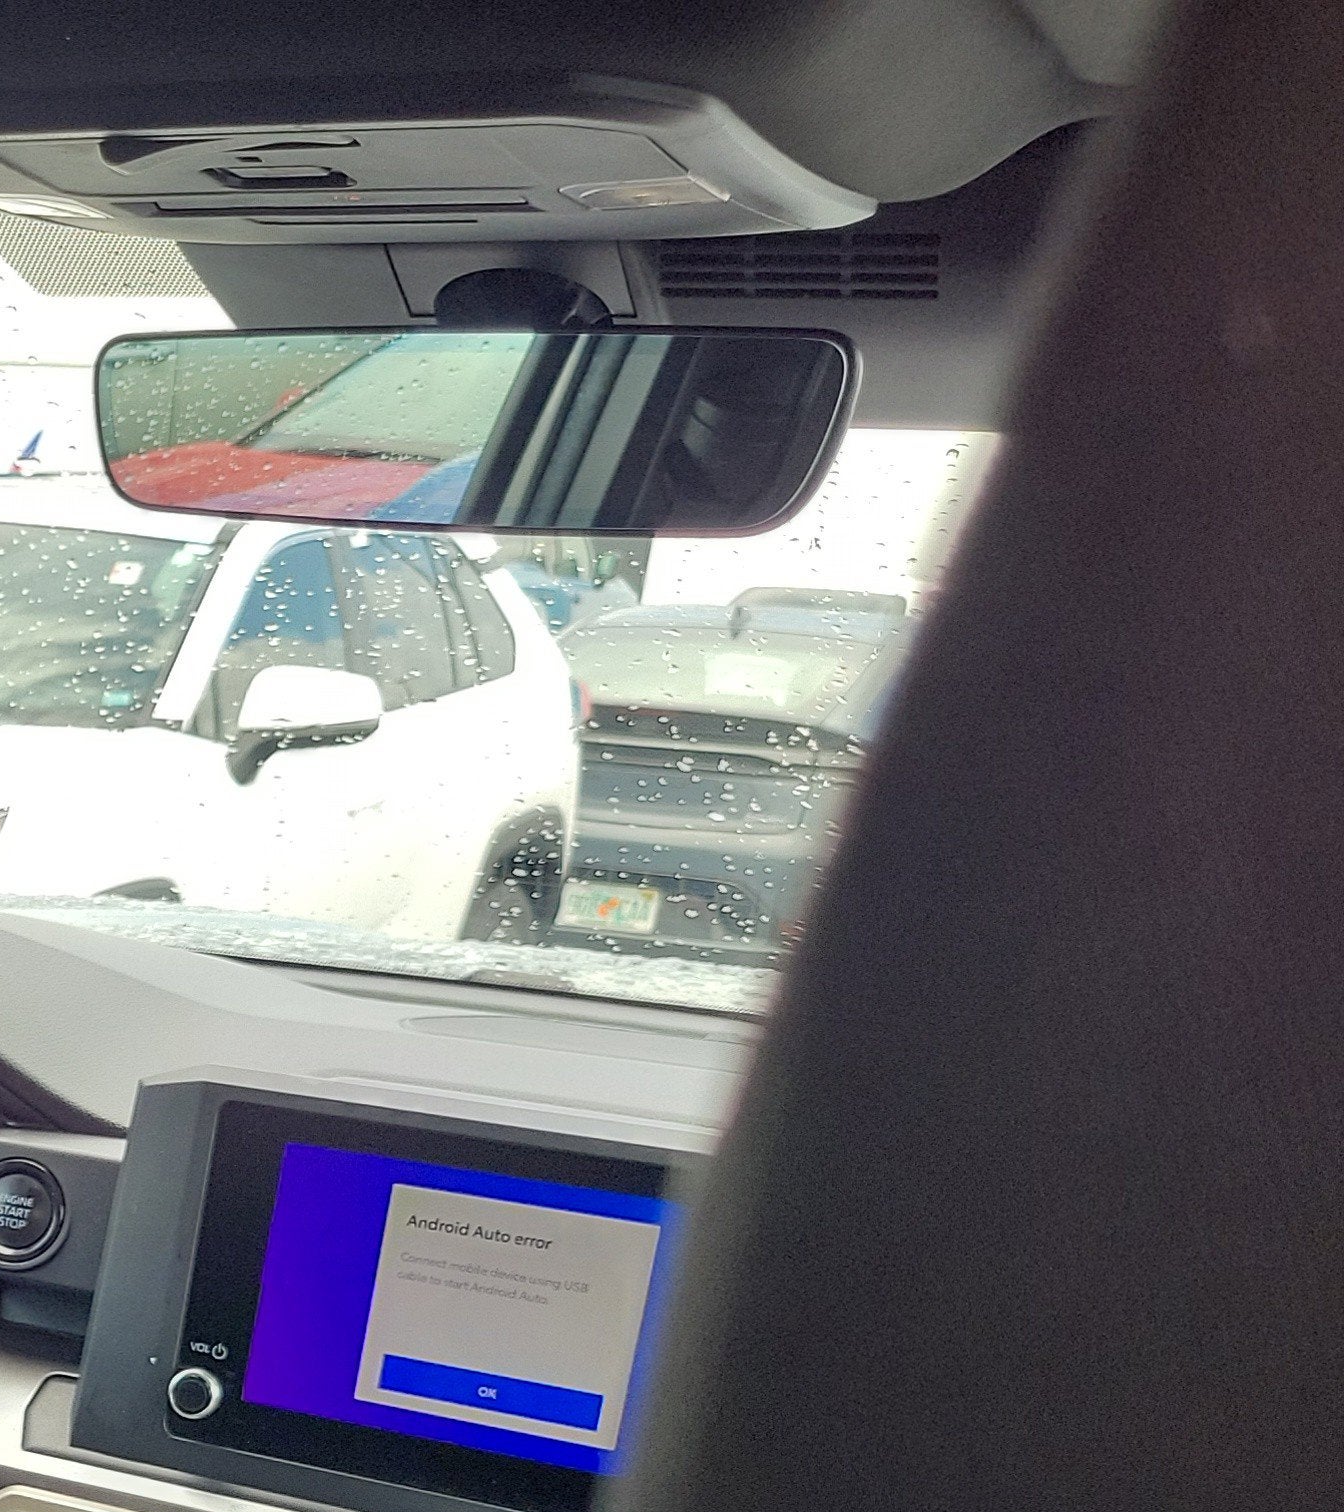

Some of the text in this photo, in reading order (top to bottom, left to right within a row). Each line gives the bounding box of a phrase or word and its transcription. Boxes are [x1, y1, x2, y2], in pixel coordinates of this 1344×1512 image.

[406, 1214, 553, 1250] Android Auto error
[190, 1341, 210, 1354] VOL
[477, 1386, 497, 1400] OK
